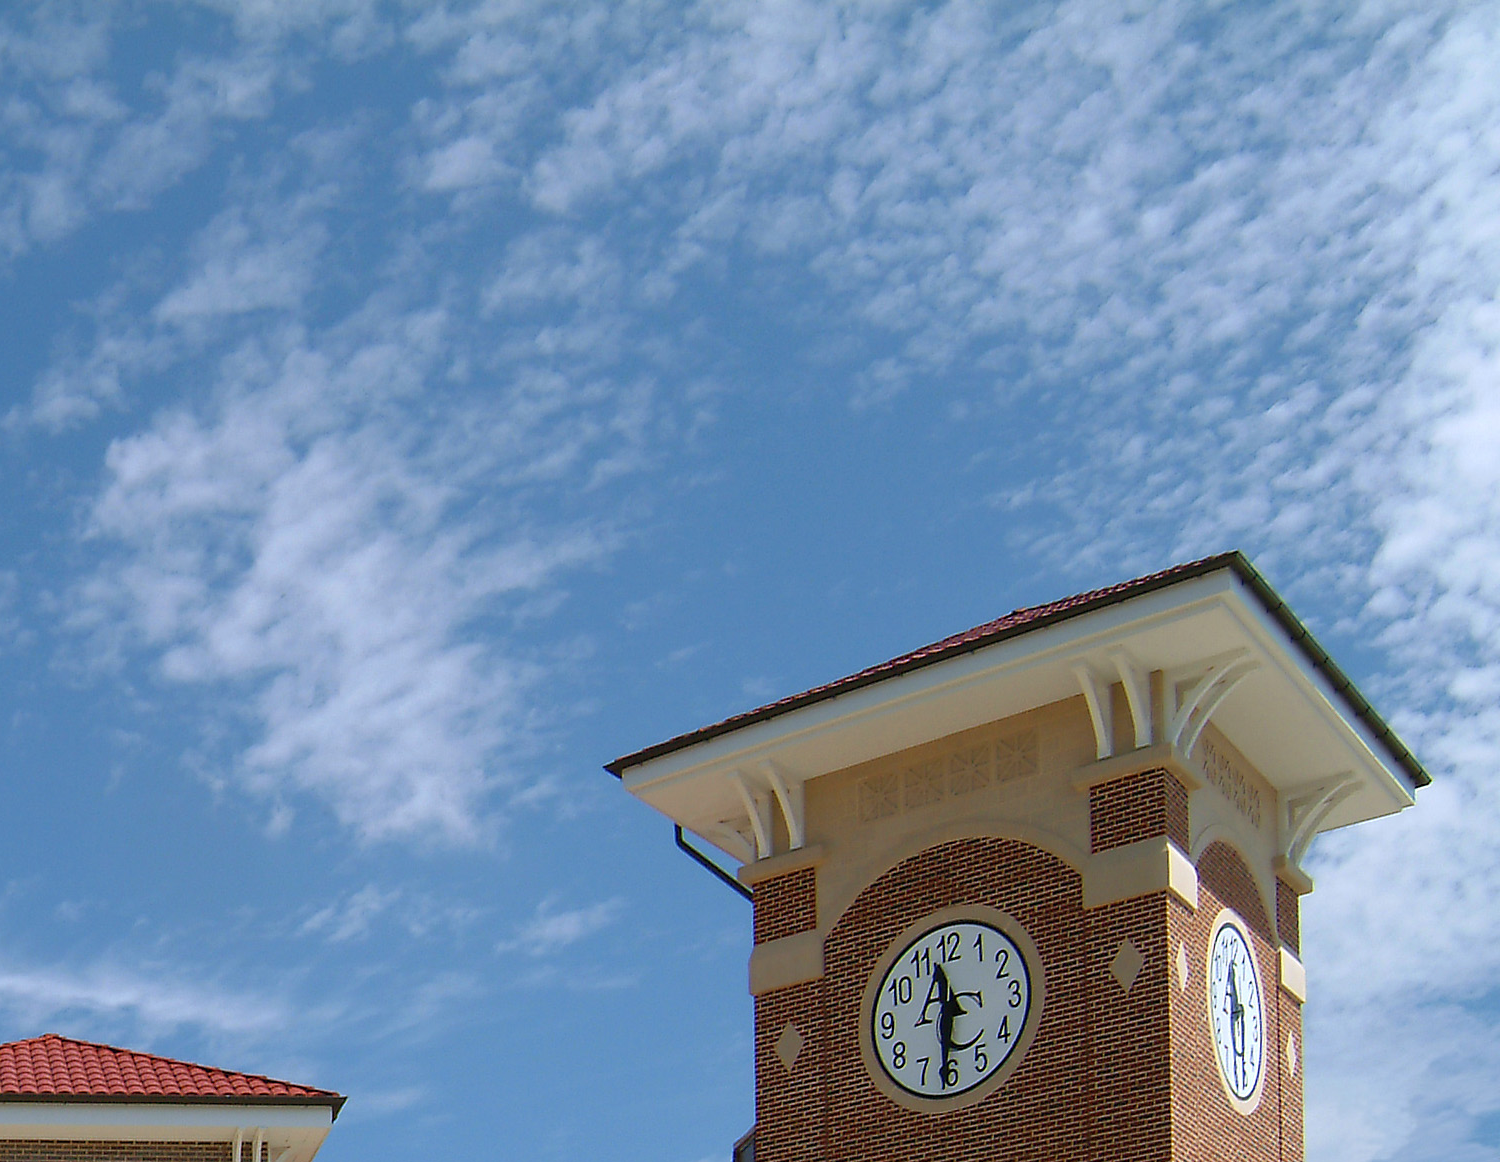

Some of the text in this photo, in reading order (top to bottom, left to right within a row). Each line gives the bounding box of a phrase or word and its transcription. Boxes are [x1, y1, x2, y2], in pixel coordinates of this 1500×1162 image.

[936, 932, 961, 963] 12
[973, 933, 983, 962] 1
[910, 947, 932, 978] 11
[995, 949, 1009, 979] 2
[888, 975, 912, 1006] 10
[1007, 979, 1022, 1008] 3
[881, 1011, 895, 1040] 9
[997, 1015, 1011, 1044] 4
[892, 1041, 906, 1069] 8
[974, 1043, 988, 1073] 5
[916, 1057, 931, 1086] 7
[944, 1059, 959, 1087] 6
